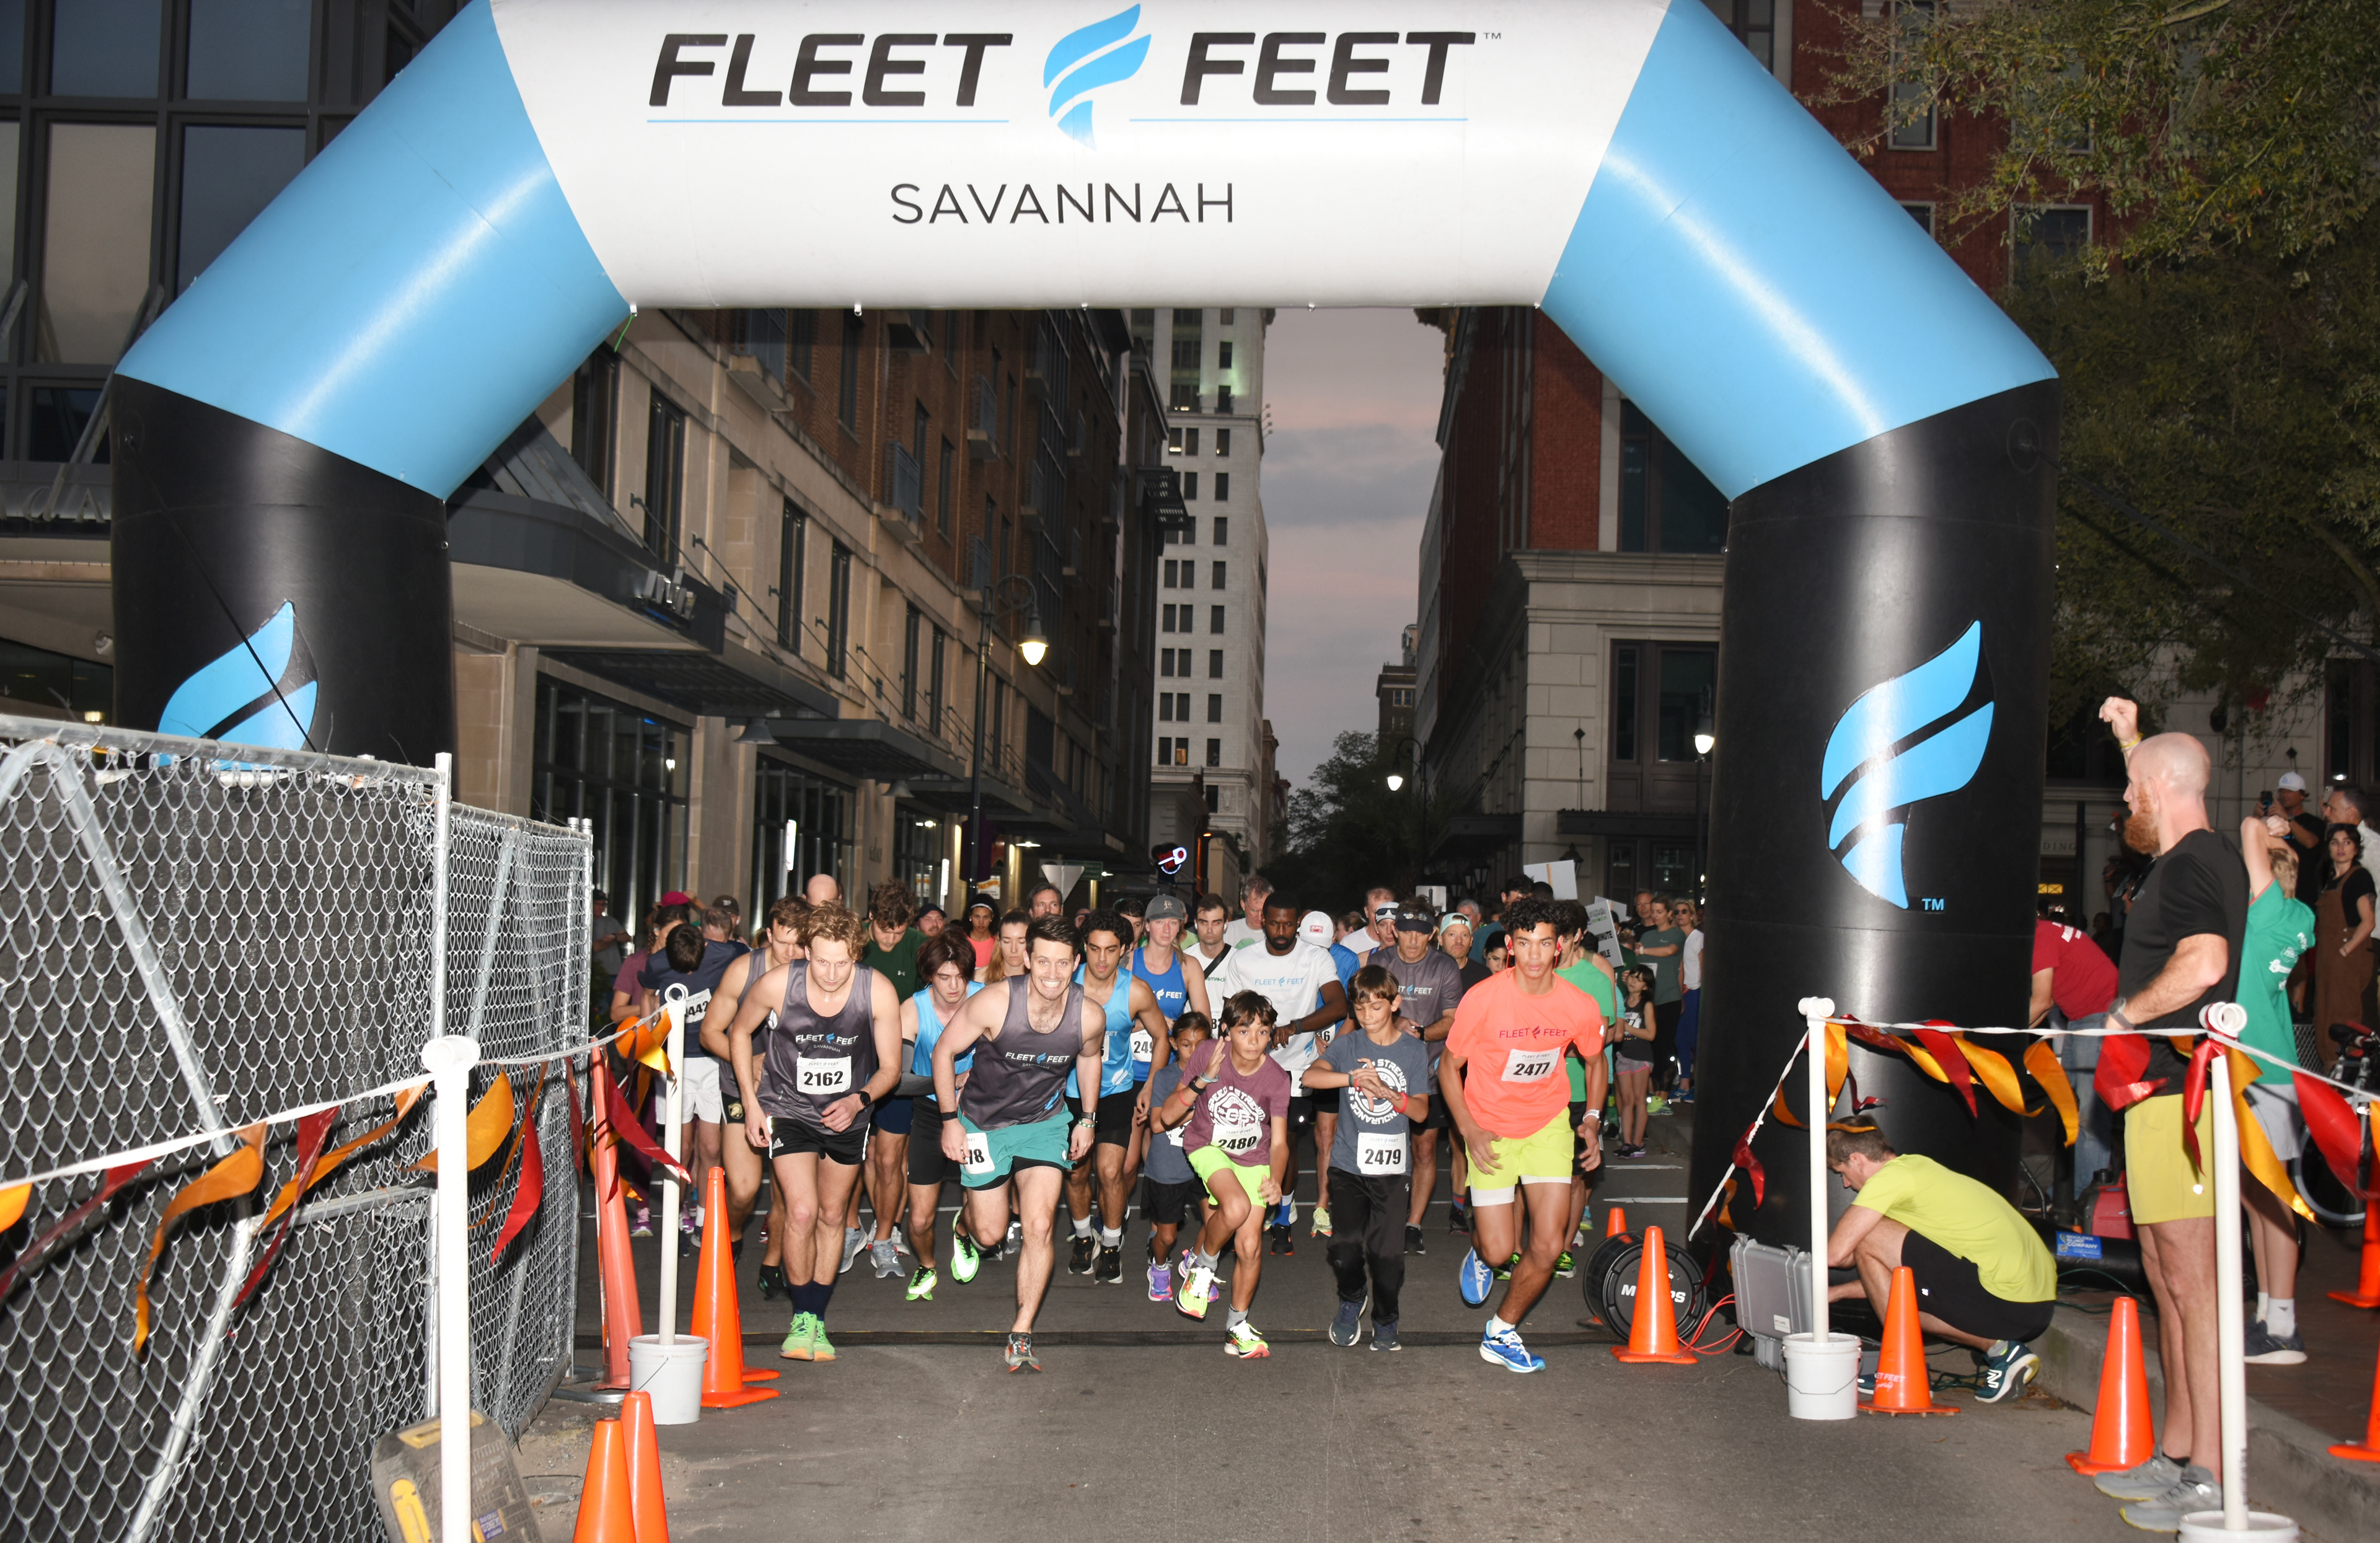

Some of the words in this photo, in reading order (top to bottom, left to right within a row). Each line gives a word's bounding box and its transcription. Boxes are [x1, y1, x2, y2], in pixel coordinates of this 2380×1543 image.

[649, 33, 1013, 107] FLEET
[1180, 32, 1476, 105] FEET
[891, 182, 1234, 224] SAVANNAH
[1921, 898, 1944, 910] TM
[795, 1034, 824, 1043] FLEET
[836, 1035, 858, 1045] FEET
[1499, 1027, 1530, 1038] FLEET
[1005, 1052, 1035, 1061] FLEET
[1377, 1058, 1407, 1093] STRENGT
[1513, 1062, 1550, 1076] 2477
[804, 1071, 844, 1086] 2162
[1350, 1102, 1399, 1125] NDURANCE
[1218, 1136, 1257, 1150] 2480
[1365, 1149, 1401, 1165] 2479
[1884, 1373, 1906, 1383] FEET
